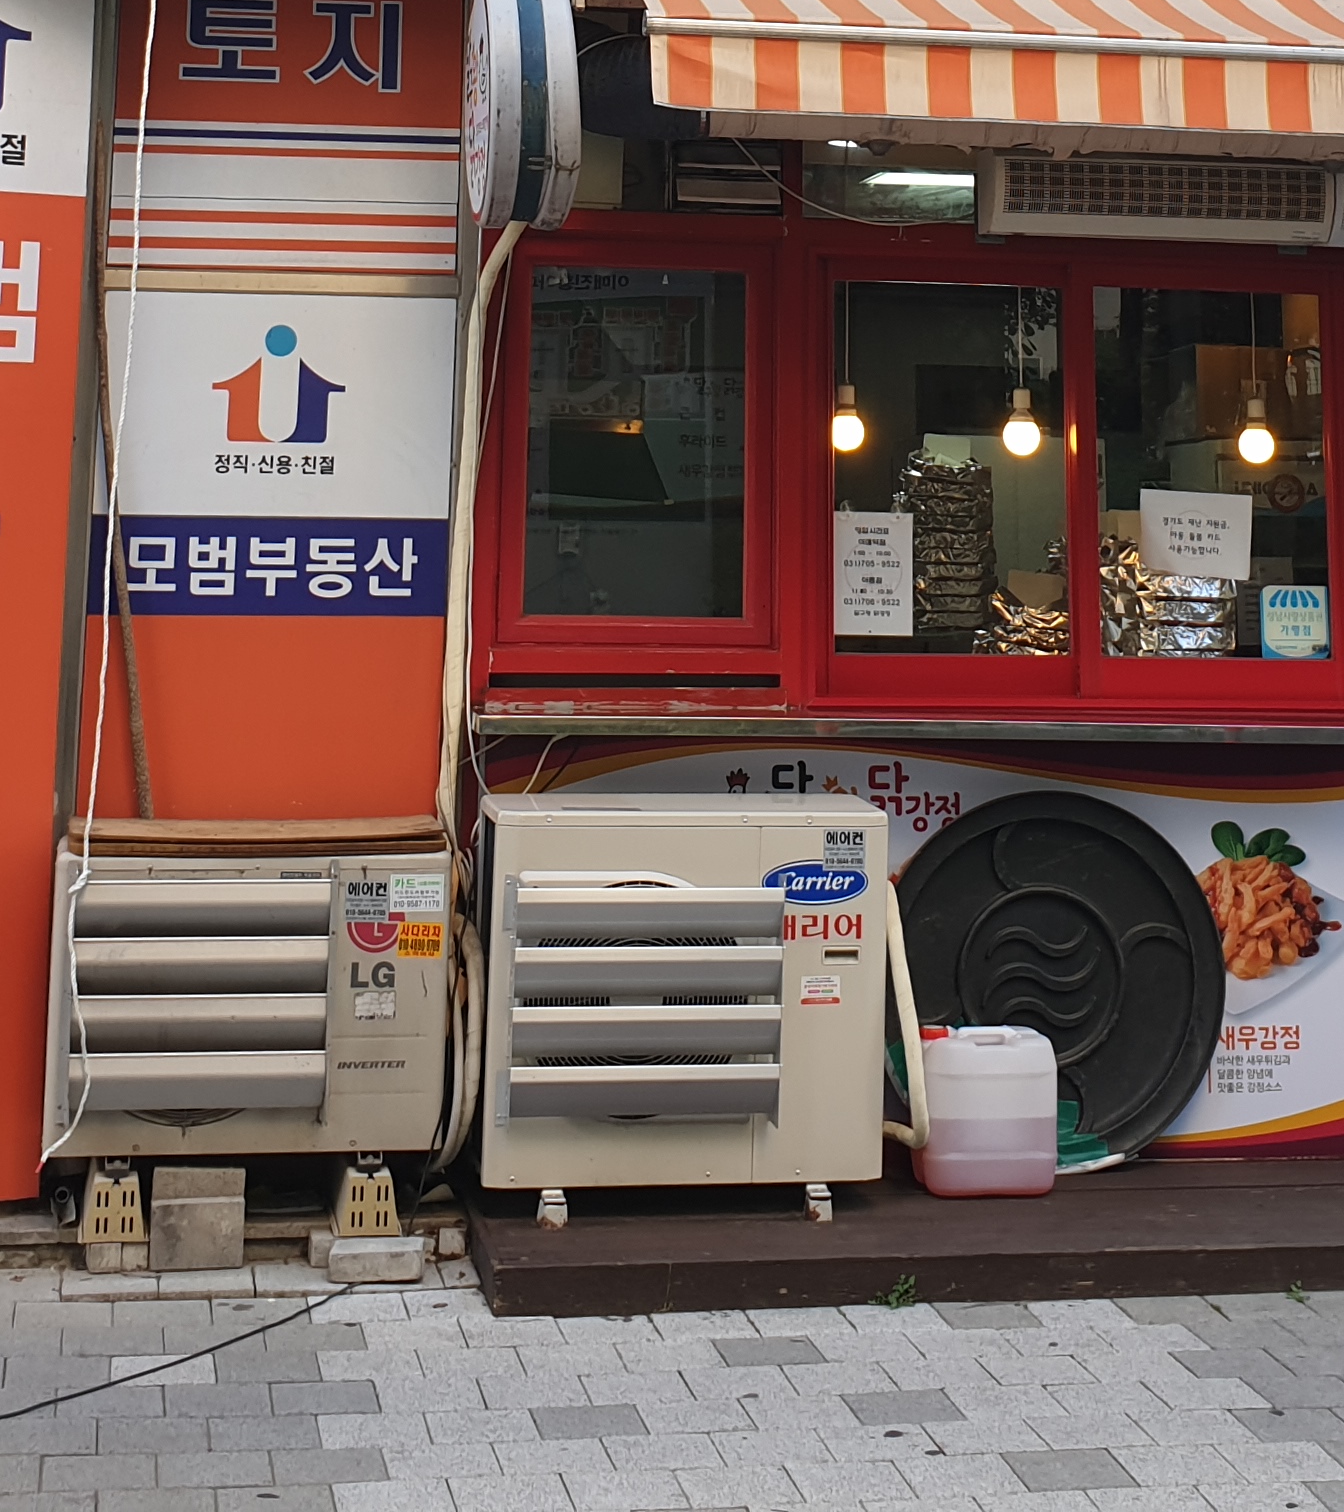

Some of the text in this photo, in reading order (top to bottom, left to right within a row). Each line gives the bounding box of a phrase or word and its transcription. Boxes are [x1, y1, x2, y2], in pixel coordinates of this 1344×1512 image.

[125, 535, 420, 600] 모범부동산
[825, 830, 864, 846] 에어컨
[347, 881, 388, 897] 에어컨
[394, 877, 417, 889] 카드
[349, 960, 396, 989] LG
[1218, 1024, 1300, 1051] 새우강정
[336, 1059, 407, 1070] INVERTER
